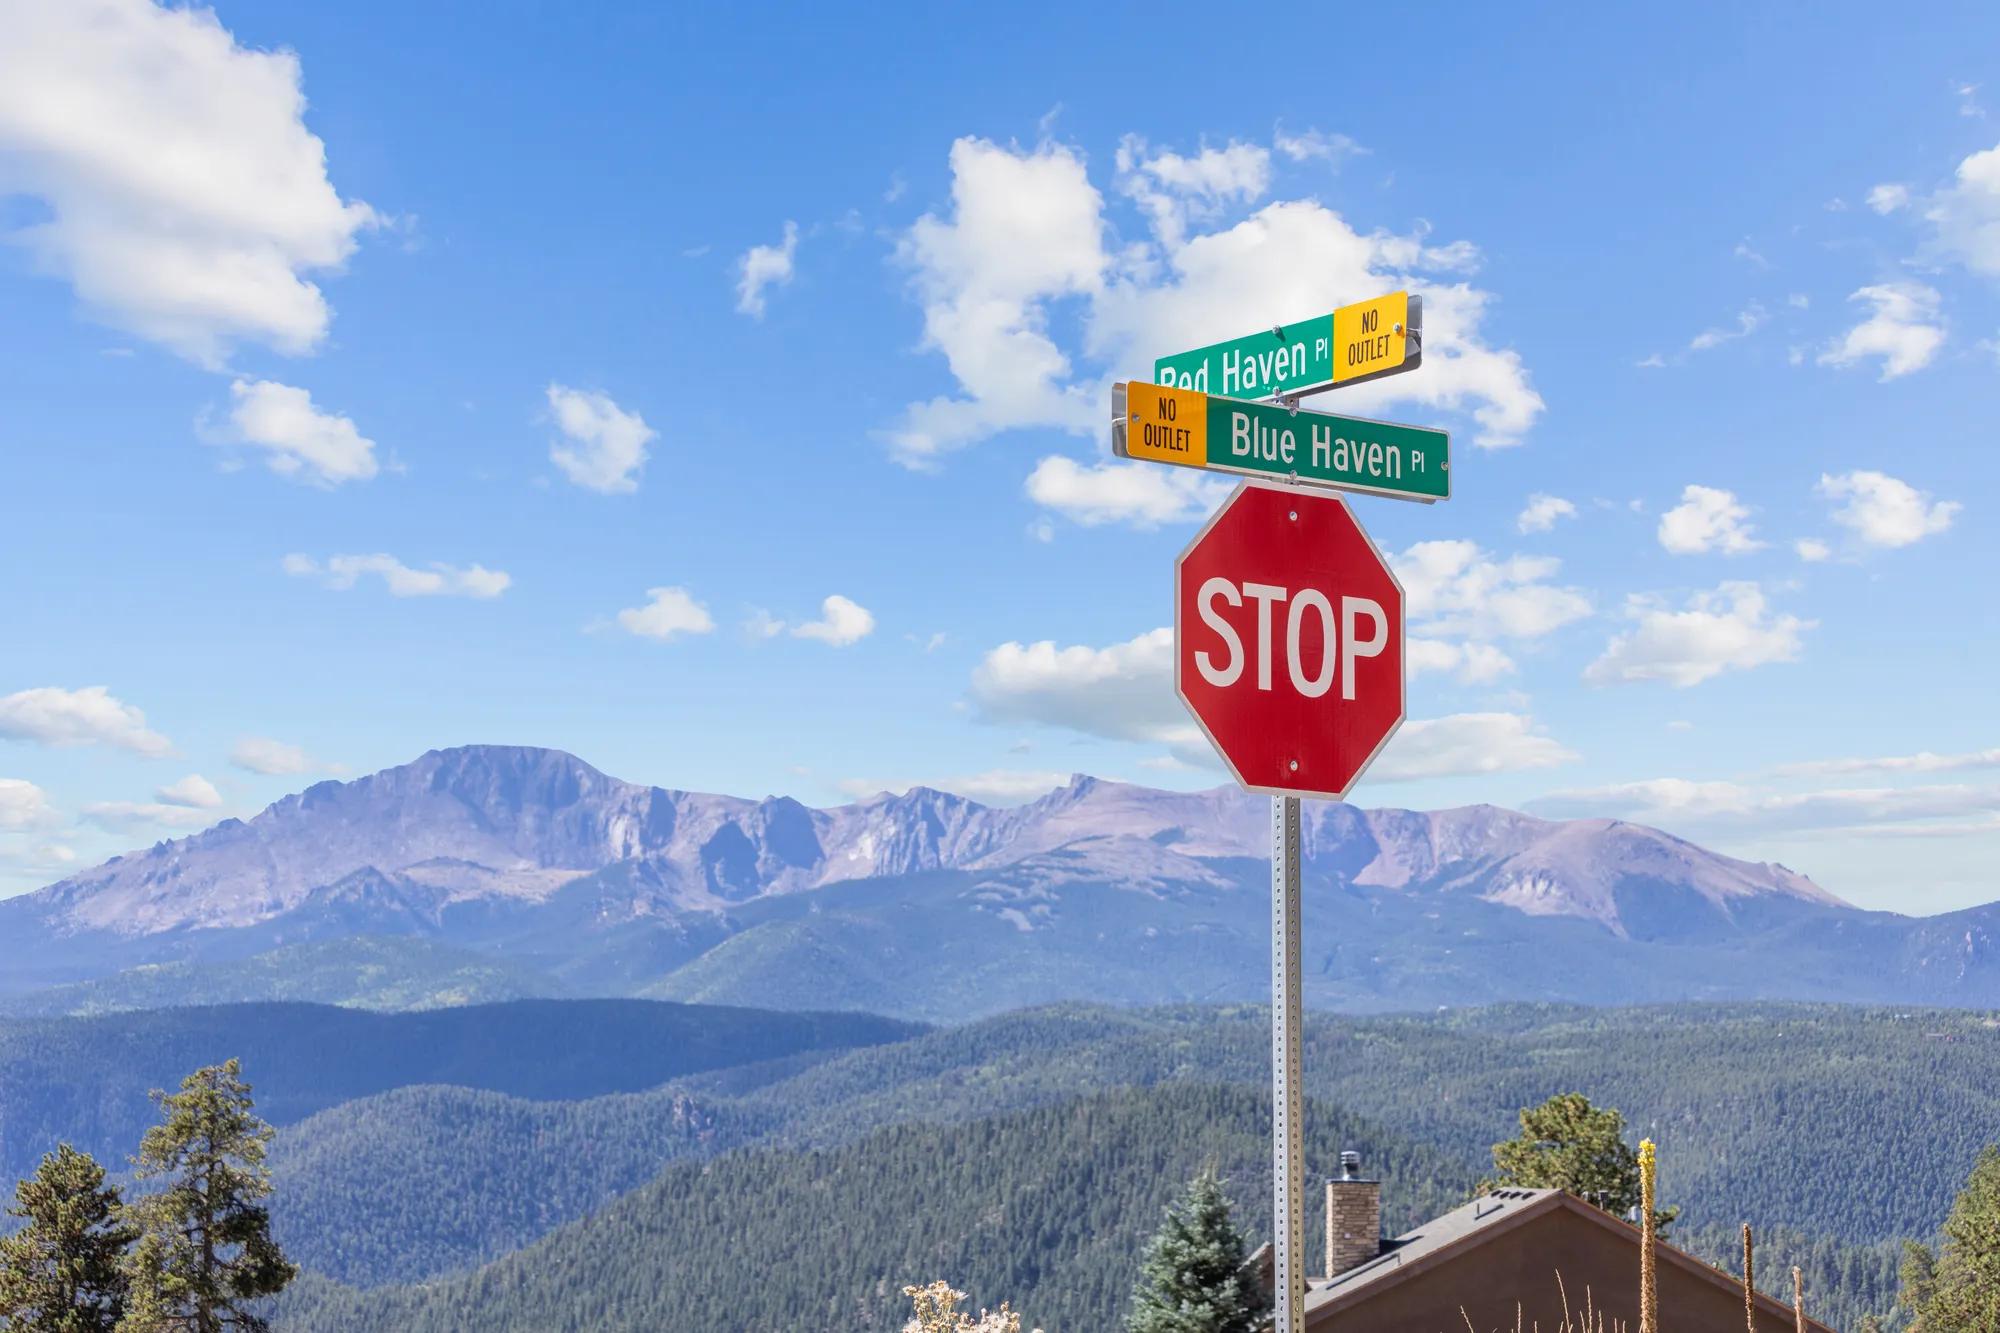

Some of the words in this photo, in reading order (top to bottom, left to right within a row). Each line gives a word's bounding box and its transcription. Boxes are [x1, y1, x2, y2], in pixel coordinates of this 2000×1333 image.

[1361, 309, 1378, 334] NO
[1223, 341, 1306, 394] Haven
[1315, 337, 1328, 362] Pl
[1348, 335, 1390, 366] OUTLET
[1158, 397, 1177, 421] NO
[1143, 423, 1191, 452] OUTLET
[1231, 411, 1296, 464] Blue
[1312, 424, 1400, 479] Haven
[1411, 450, 1424, 473] Pl
[1194, 577, 1389, 700] STOP
